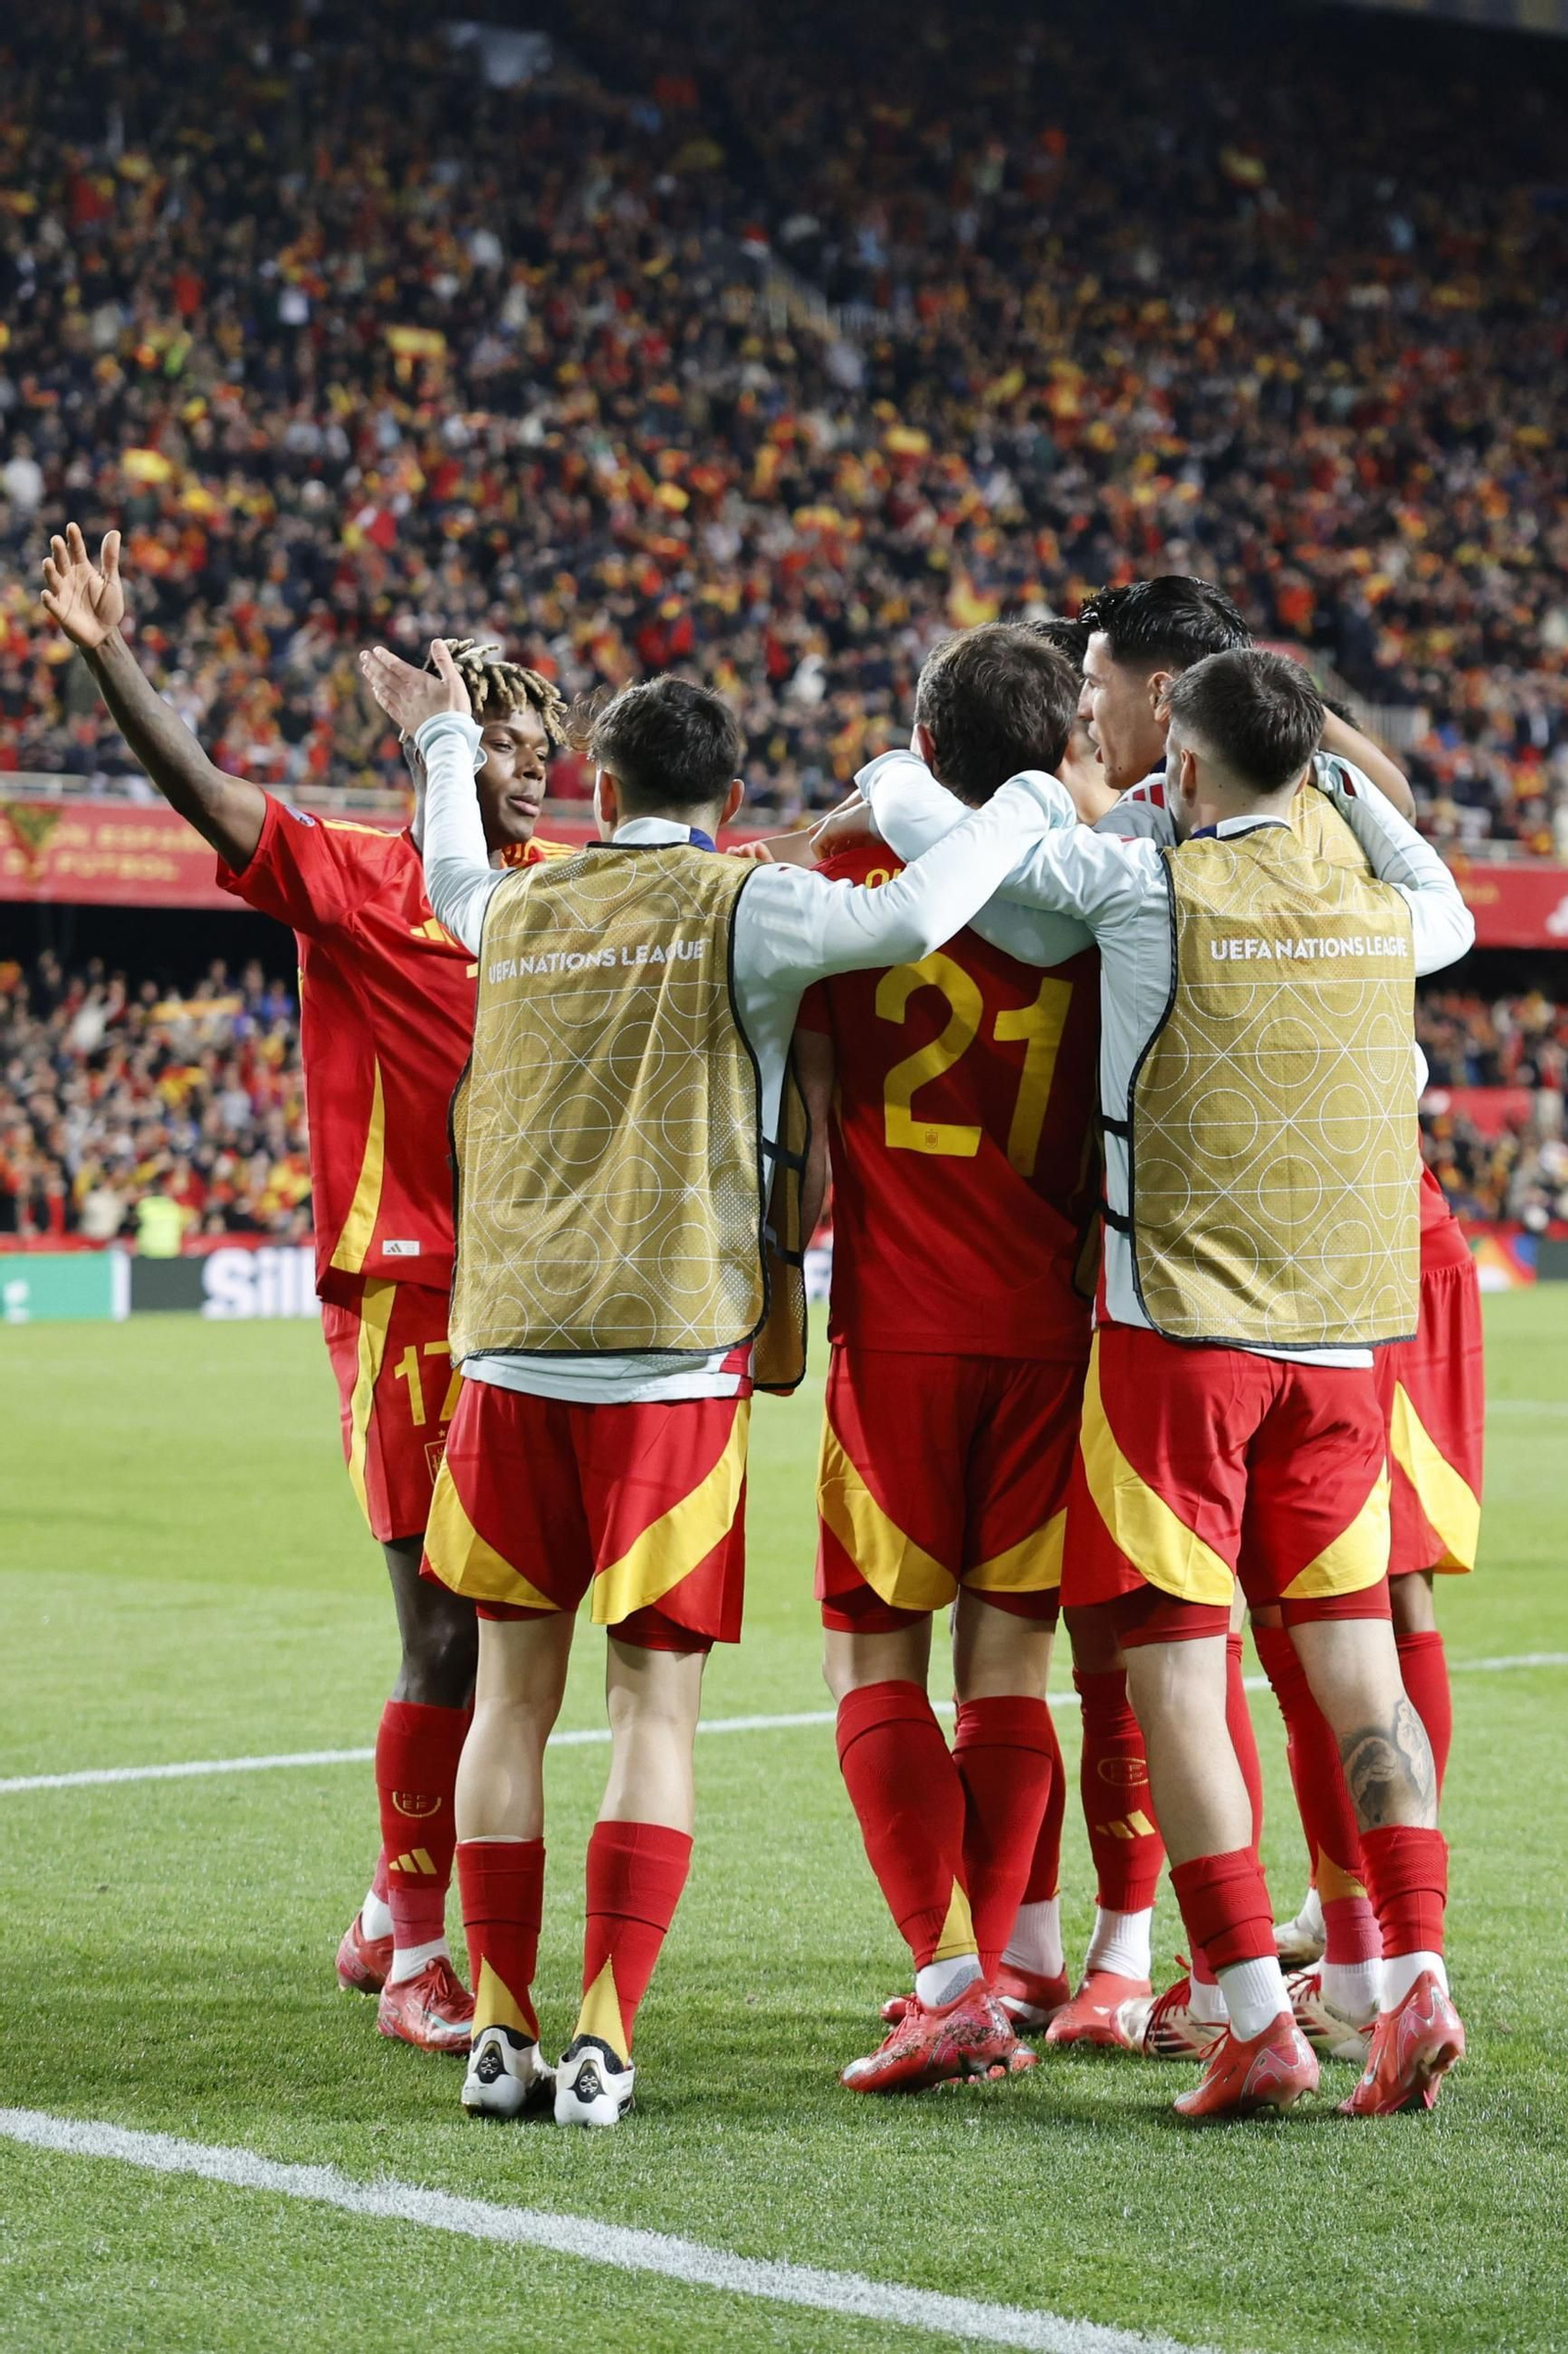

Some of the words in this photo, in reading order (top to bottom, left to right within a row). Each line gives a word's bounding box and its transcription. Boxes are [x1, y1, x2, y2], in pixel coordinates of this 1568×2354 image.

[488, 958, 517, 985] UEFA
[519, 947, 615, 975] NATIONS
[621, 938, 710, 966] LEAGUE
[1210, 938, 1273, 960] UEFA
[1275, 936, 1365, 959] NATIONS
[875, 952, 1073, 1177] 21
[394, 1341, 465, 1426] 17
